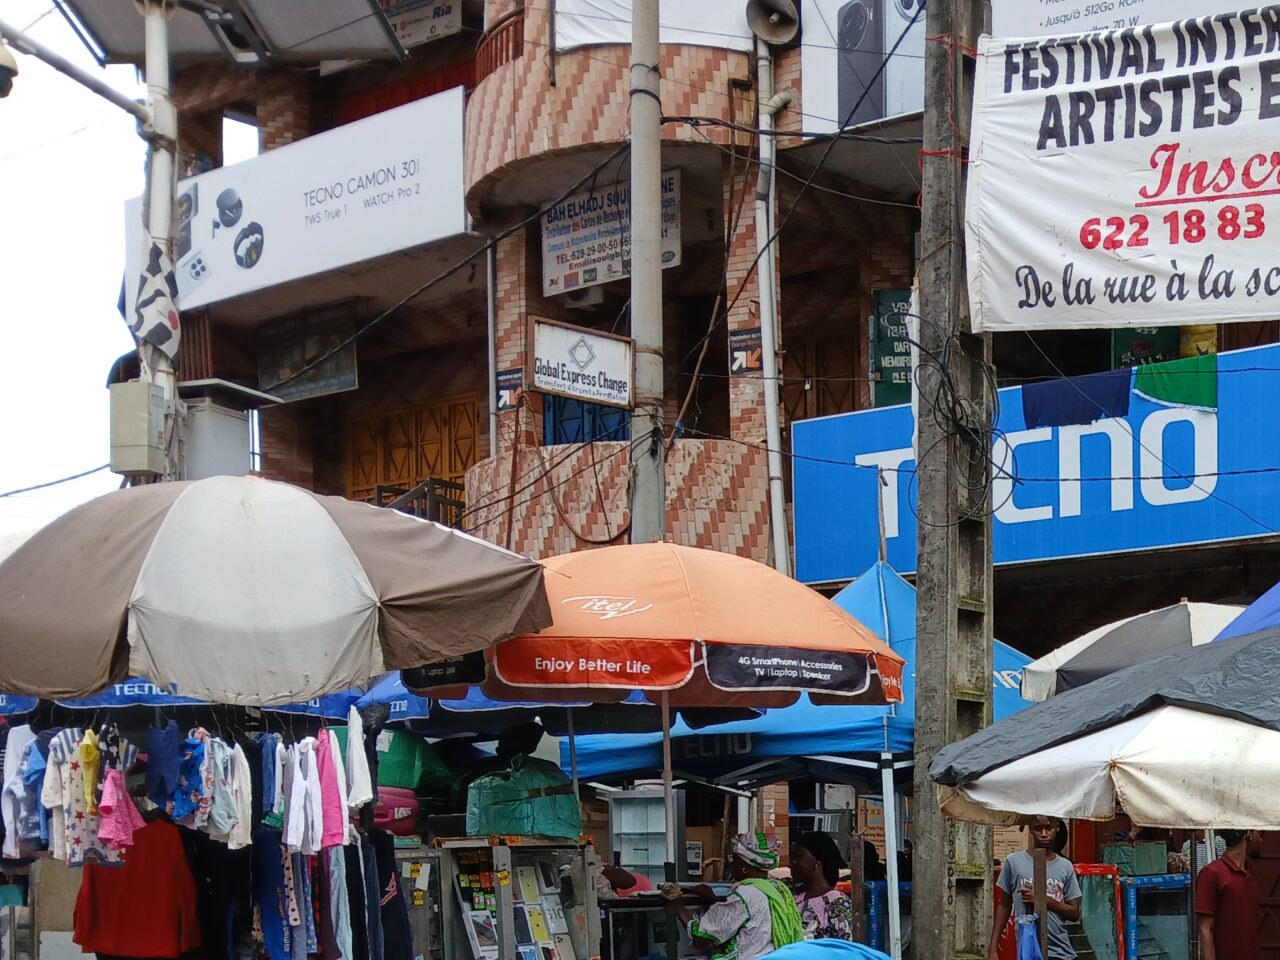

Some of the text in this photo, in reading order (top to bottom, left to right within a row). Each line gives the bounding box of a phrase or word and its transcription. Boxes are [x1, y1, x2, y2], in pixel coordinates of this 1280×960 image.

[432, 5, 453, 20] Ria
[1044, 9, 1081, 29] Jusqu'à
[1084, 2, 1116, 18] 512Go
[1128, 16, 1140, 27] W
[1003, 24, 1166, 94] FESTIVAL
[1036, 66, 1243, 151] ARTISTES
[303, 182, 344, 208] TECNO
[346, 165, 397, 195] CAMON
[400, 158, 417, 179] 30
[304, 212, 322, 227] TWS
[324, 207, 342, 221] True
[363, 190, 394, 209] WATCH
[398, 186, 412, 200] Pro
[414, 182, 421, 195] 2
[546, 203, 566, 224] BAH
[567, 196, 604, 220] ELHADJ
[1079, 213, 1149, 251] 622
[1162, 208, 1207, 245] 18
[1216, 203, 1266, 241] 83
[1014, 263, 1056, 310] De
[1061, 262, 1096, 304] la
[1103, 273, 1158, 304] rue
[1165, 259, 1190, 300] à
[1198, 253, 1237, 300] la
[534, 356, 560, 380] Global
[561, 363, 597, 388] Express
[597, 370, 628, 394] Change
[534, 655, 652, 675] Enjoy Better Life
[738, 655, 844, 672] 4G SmartPhone Accessories
[754, 667, 832, 682] TV Laptop Speaker
